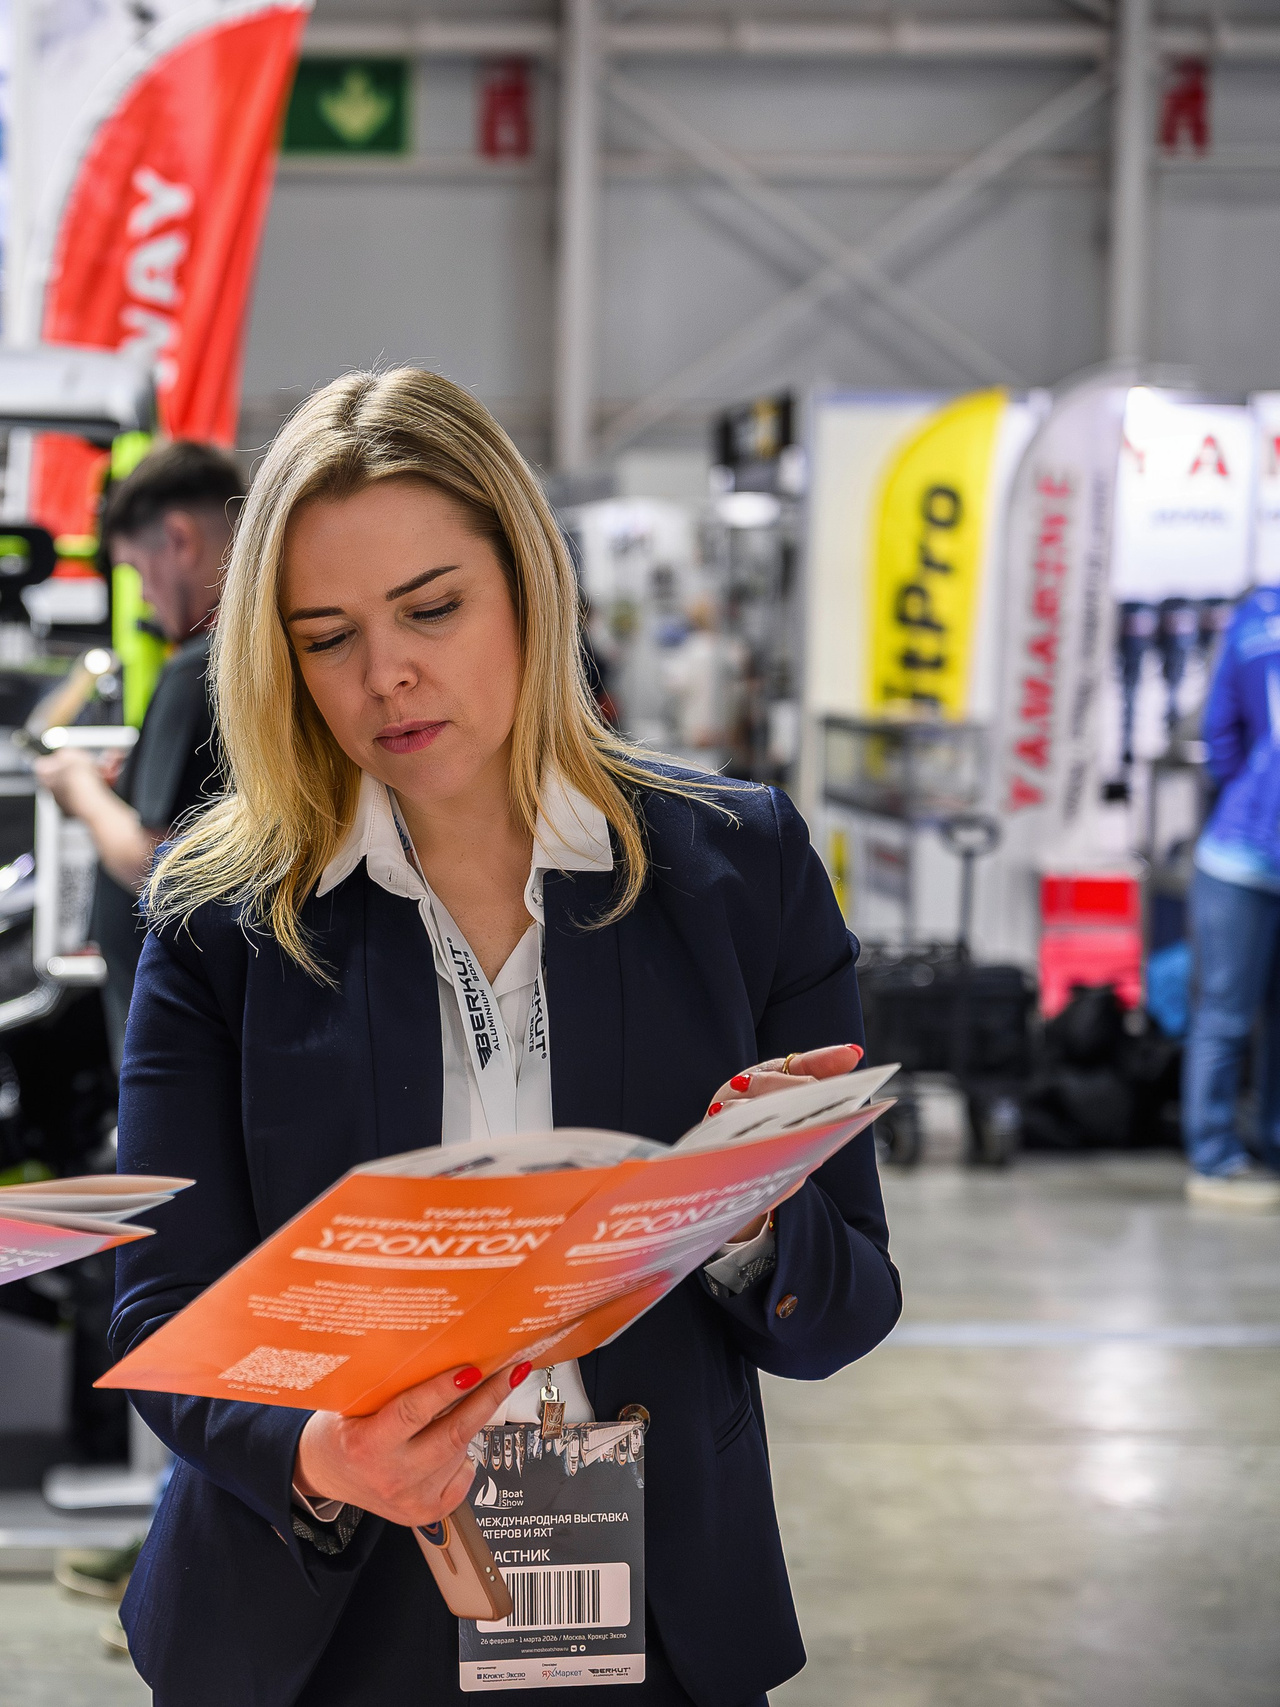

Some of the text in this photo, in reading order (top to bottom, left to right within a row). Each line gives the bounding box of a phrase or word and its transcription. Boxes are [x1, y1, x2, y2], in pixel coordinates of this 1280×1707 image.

[463, 951, 501, 1051] ALUMINIUM BOATS
[423, 1206, 513, 1220] ТОВАРЫ
[502, 1489, 524, 1498] Boat
[502, 1499, 524, 1507] Show
[476, 1512, 629, 1528] МЕЖДУНАРОДНАЯ ВЫСТАВКА
[482, 1527, 554, 1539] АТЕРОВ И ЯХТ
[491, 1549, 551, 1563] АСТНИК
[489, 1637, 515, 1646] февраля
[523, 1636, 542, 1645] марта
[542, 1635, 558, 1643] 2026
[563, 1634, 587, 1642] Москва,
[587, 1633, 609, 1642] Крокус
[609, 1632, 627, 1641] Экспо
